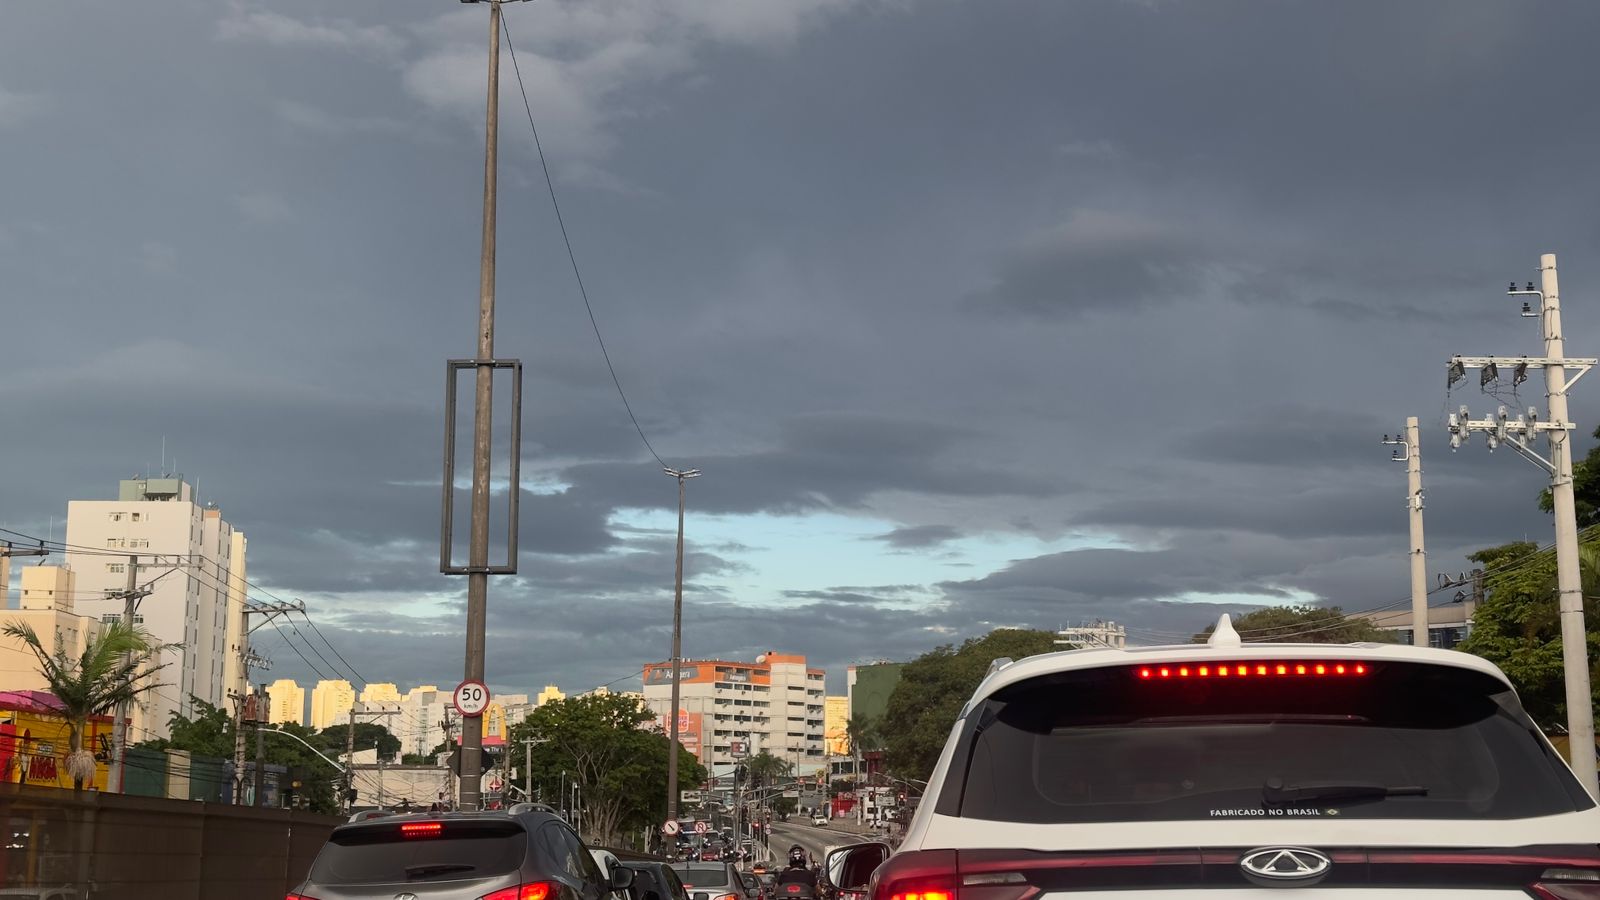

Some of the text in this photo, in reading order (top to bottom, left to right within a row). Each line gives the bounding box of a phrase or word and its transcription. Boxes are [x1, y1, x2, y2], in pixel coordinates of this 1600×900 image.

[462, 688, 482, 701] 50
[1210, 808, 1321, 817] FABRICADO NO BRASIL
